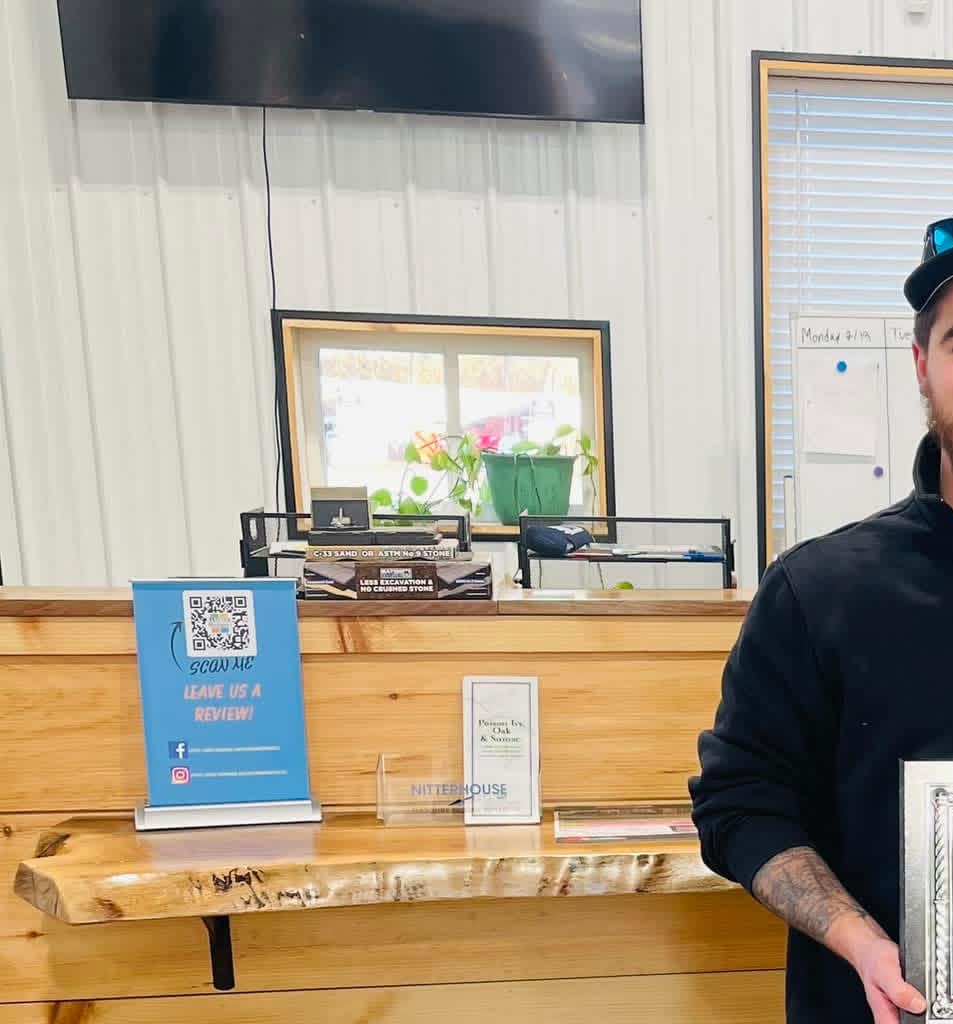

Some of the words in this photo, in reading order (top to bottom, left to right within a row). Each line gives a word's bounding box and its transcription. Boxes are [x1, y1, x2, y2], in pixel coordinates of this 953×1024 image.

[801, 327, 840, 344] Monday
[231, 655, 255, 671] ME
[184, 683, 224, 700] LEAVE
[229, 683, 248, 699] US
[251, 683, 262, 697] A
[411, 783, 507, 795] NITTERHOUSE
